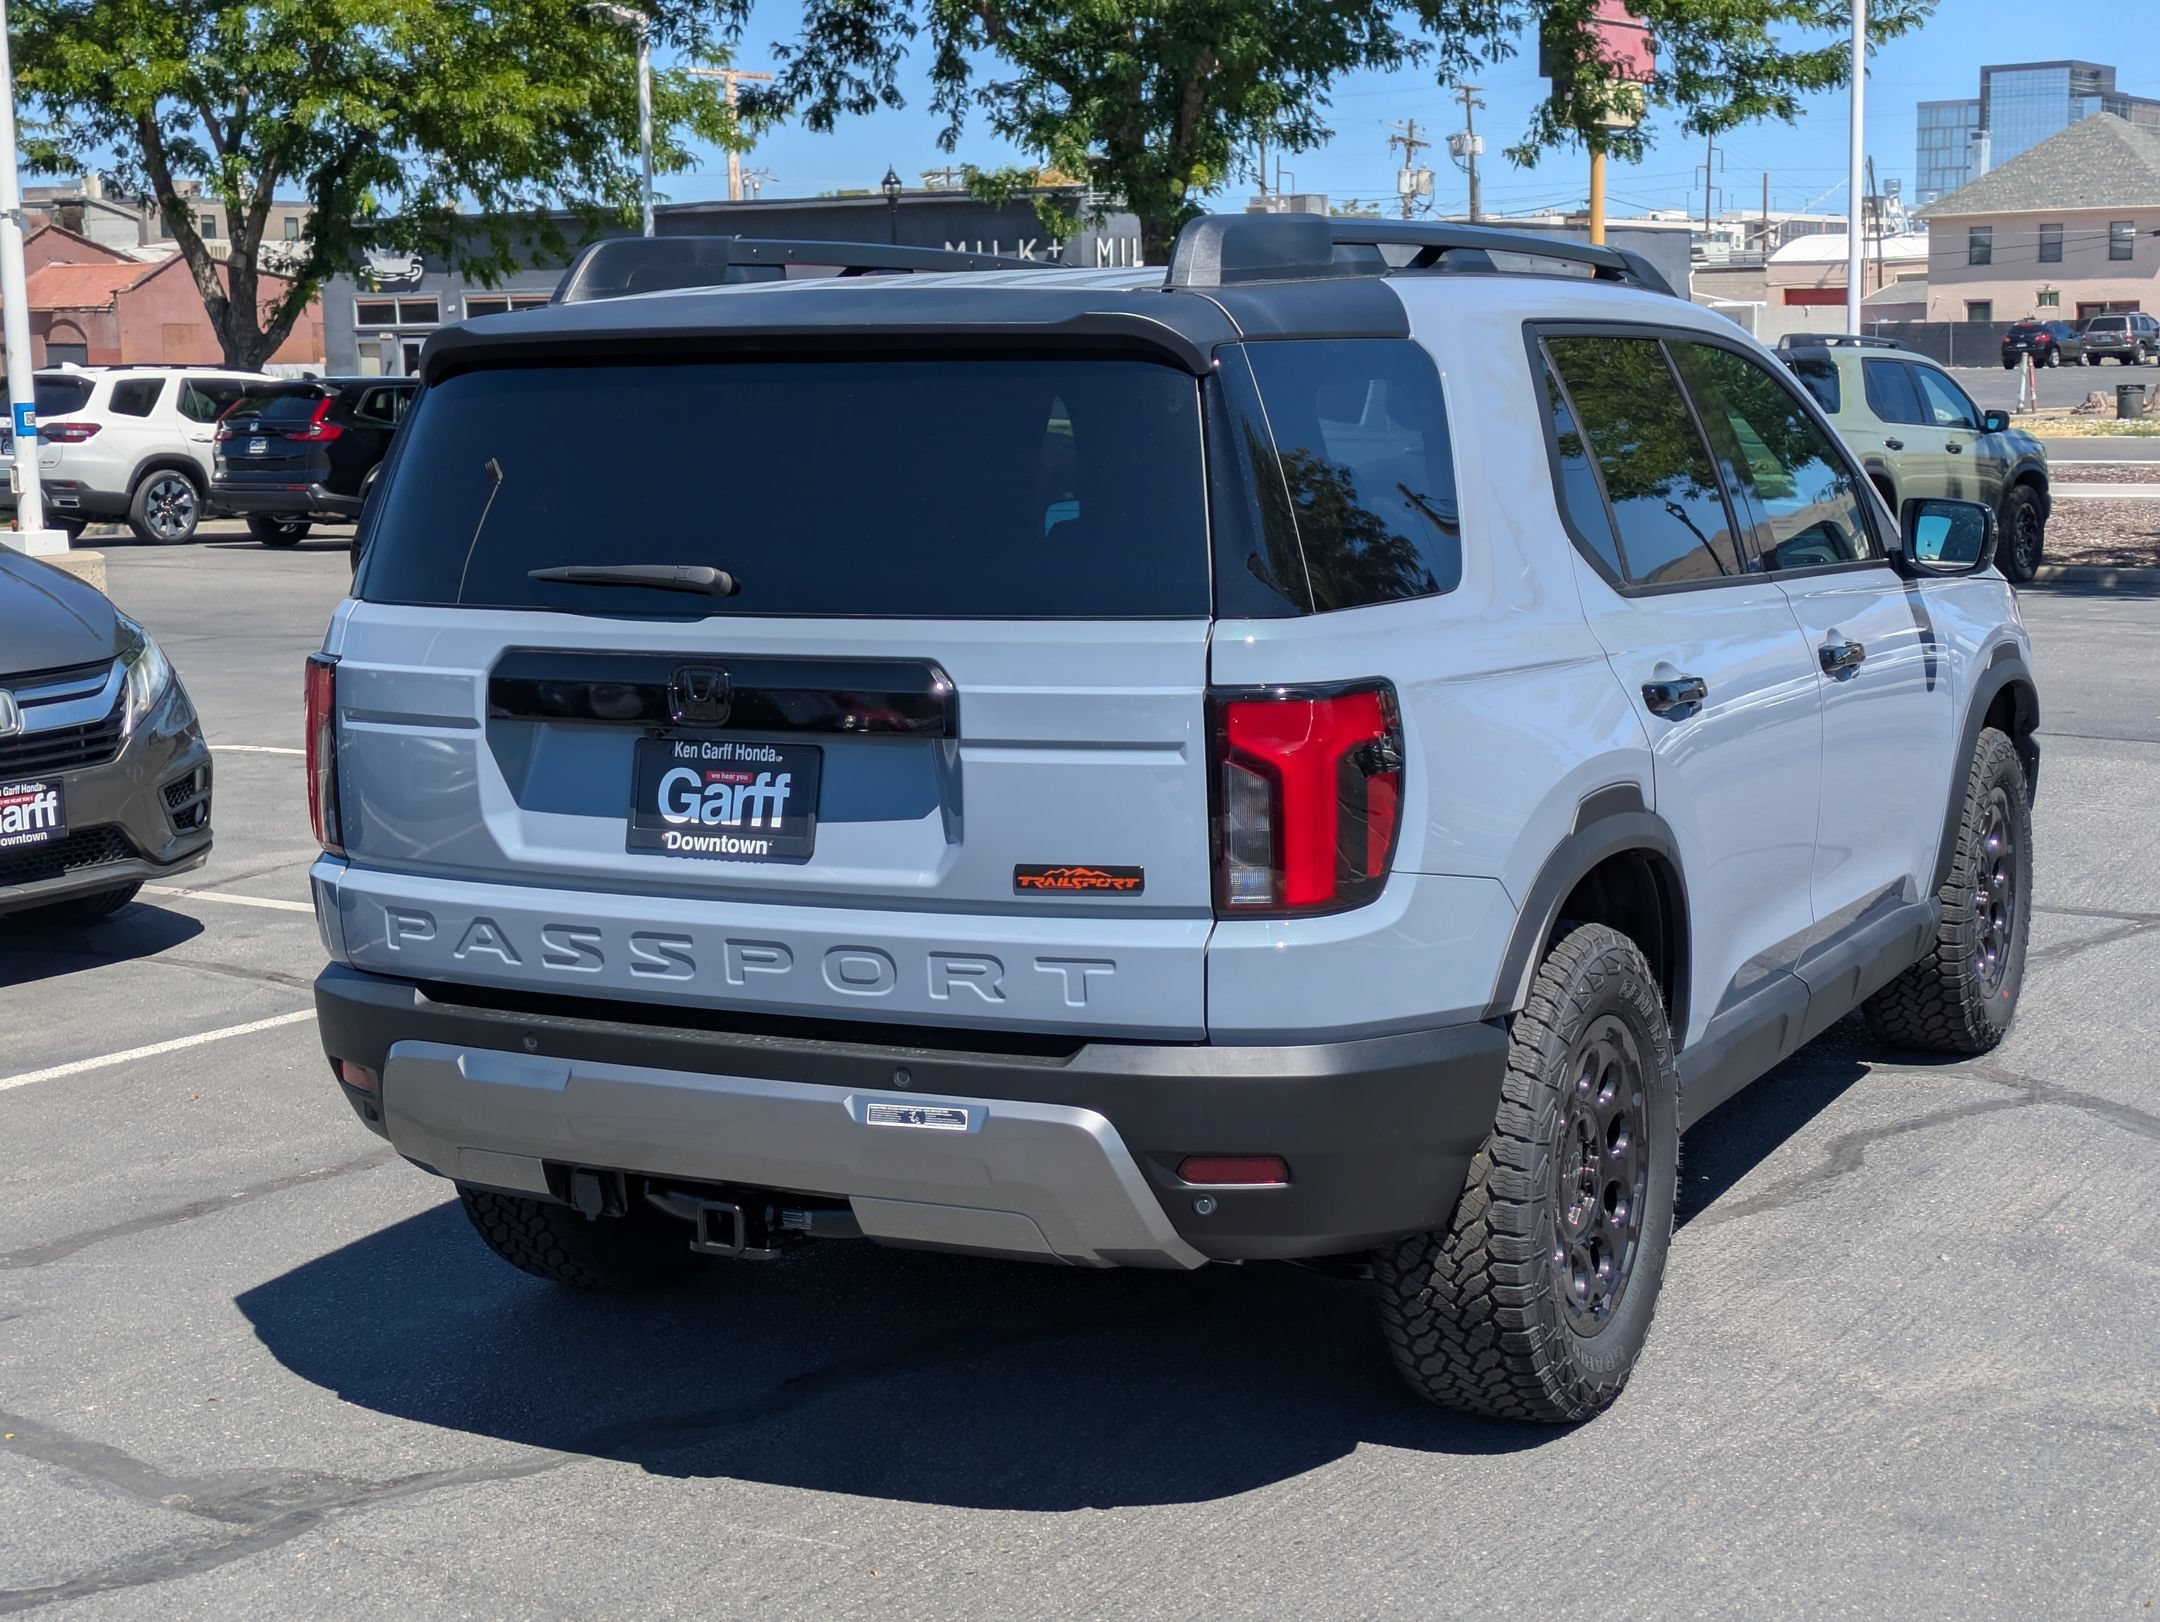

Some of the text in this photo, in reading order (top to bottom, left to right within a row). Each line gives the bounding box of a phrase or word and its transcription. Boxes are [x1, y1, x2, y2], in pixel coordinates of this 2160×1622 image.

[674, 741, 776, 762] Ken Garff Honda
[721, 772, 735, 780] hear
[3, 784, 21, 796] Garff
[657, 767, 791, 828] Garff
[0, 791, 57, 833] arff
[0, 831, 48, 846] owntown
[667, 831, 768, 855] Downtown
[1017, 876, 1140, 890] TRAILSPORT
[384, 904, 1116, 1008] PASSPORT
[1617, 978, 1671, 1090] GENERAL
